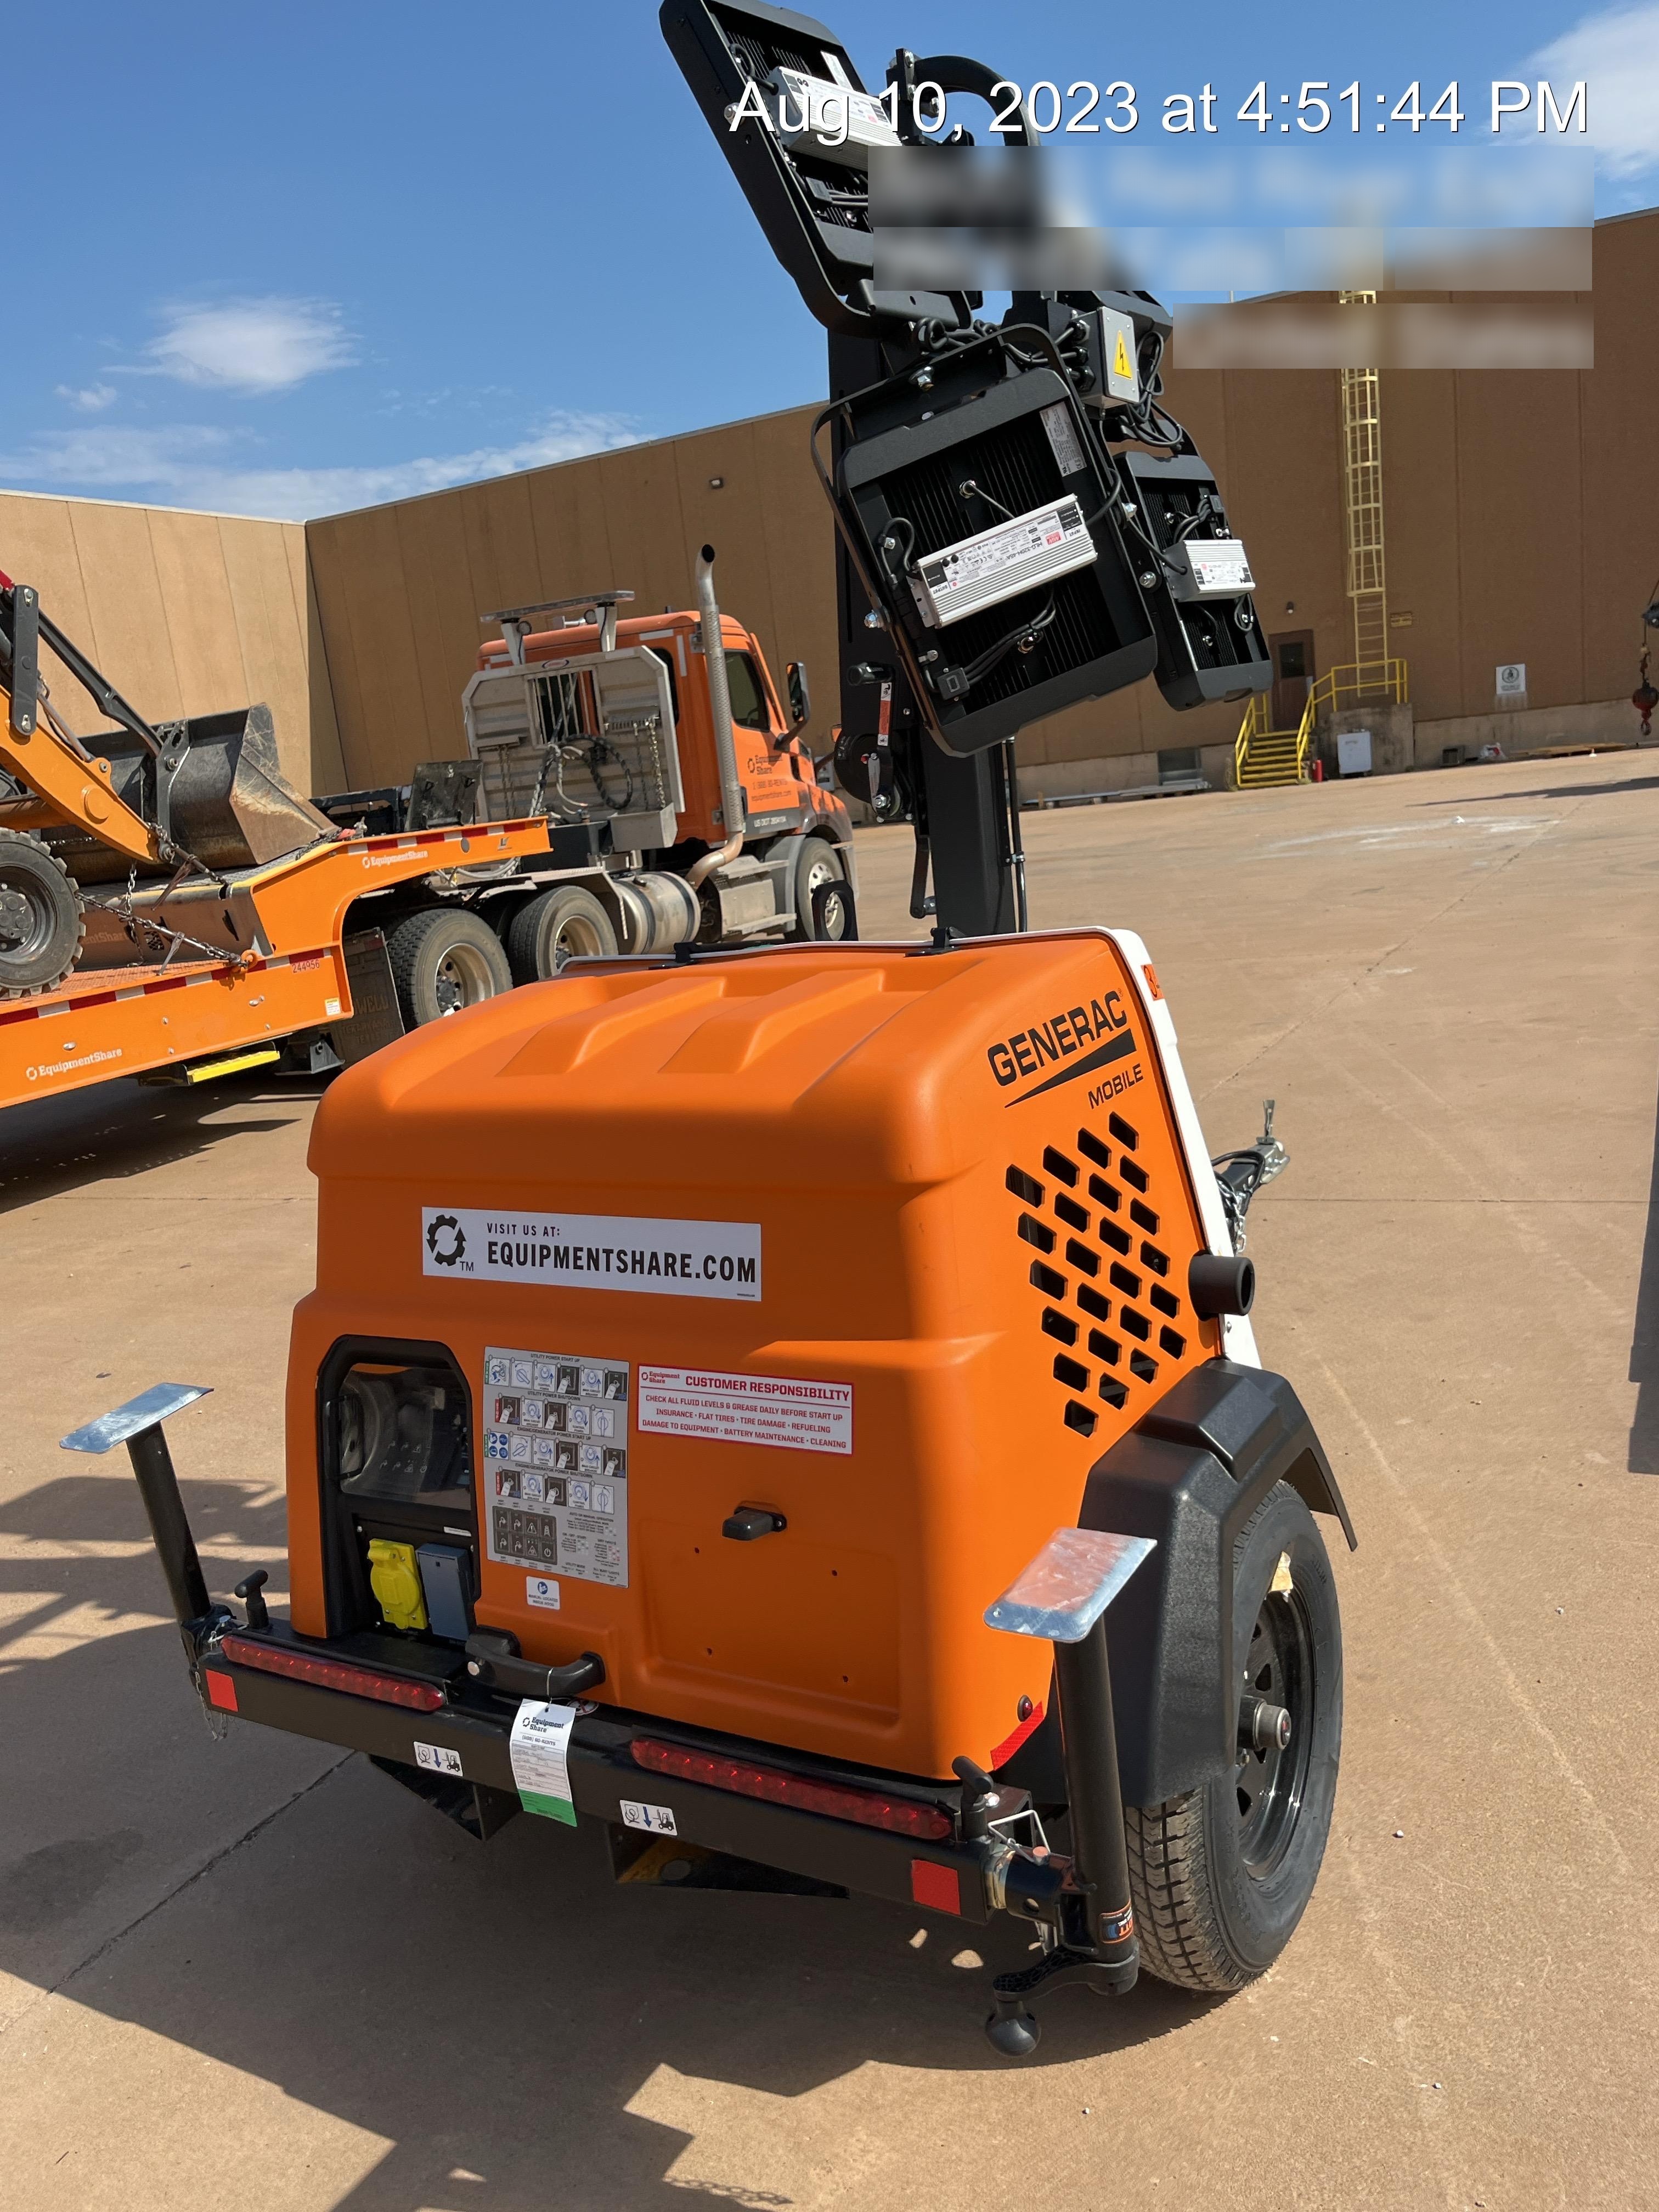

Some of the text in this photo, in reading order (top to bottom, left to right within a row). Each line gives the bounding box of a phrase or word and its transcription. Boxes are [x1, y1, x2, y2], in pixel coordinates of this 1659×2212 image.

[371, 851, 428, 867] EquipmentShare
[292, 959, 320, 973] 244956
[988, 991, 1127, 1086] GENERAC
[38, 1048, 122, 1077] EquipmentShare
[1088, 1063, 1144, 1109] MOBILE
[487, 1223, 560, 1237] VISIT US AT:
[459, 1261, 474, 1272] TM
[488, 1241, 755, 1283] EQUIPMENTSHARE.COM
[649, 1371, 680, 1379] Equipment
[685, 1375, 850, 1401] CUSTOMER RESPONSIBILITY
[645, 1395, 667, 1403] CHECK
[680, 1398, 699, 1406] FLUID
[701, 1400, 724, 1409] LEVELS
[732, 1403, 758, 1412] GREASE
[760, 1406, 779, 1414] DAILY
[781, 1408, 808, 1417] BEFORE
[809, 1411, 831, 1420] START
[656, 1408, 693, 1418] INSURANCE
[715, 1414, 735, 1423] TIRES
[758, 1419, 786, 1428] DAMAGE
[792, 1423, 831, 1433] REFUELING
[642, 1419, 669, 1428] DAMAGE
[680, 1424, 719, 1434] EQUIPMENT
[724, 1429, 753, 1437] BATTERY
[755, 1431, 805, 1443] MAINTENANCE
[810, 1438, 846, 1448] CLEANING
[529, 1724, 547, 1733] Share
[532, 1717, 564, 1729] Equipment
